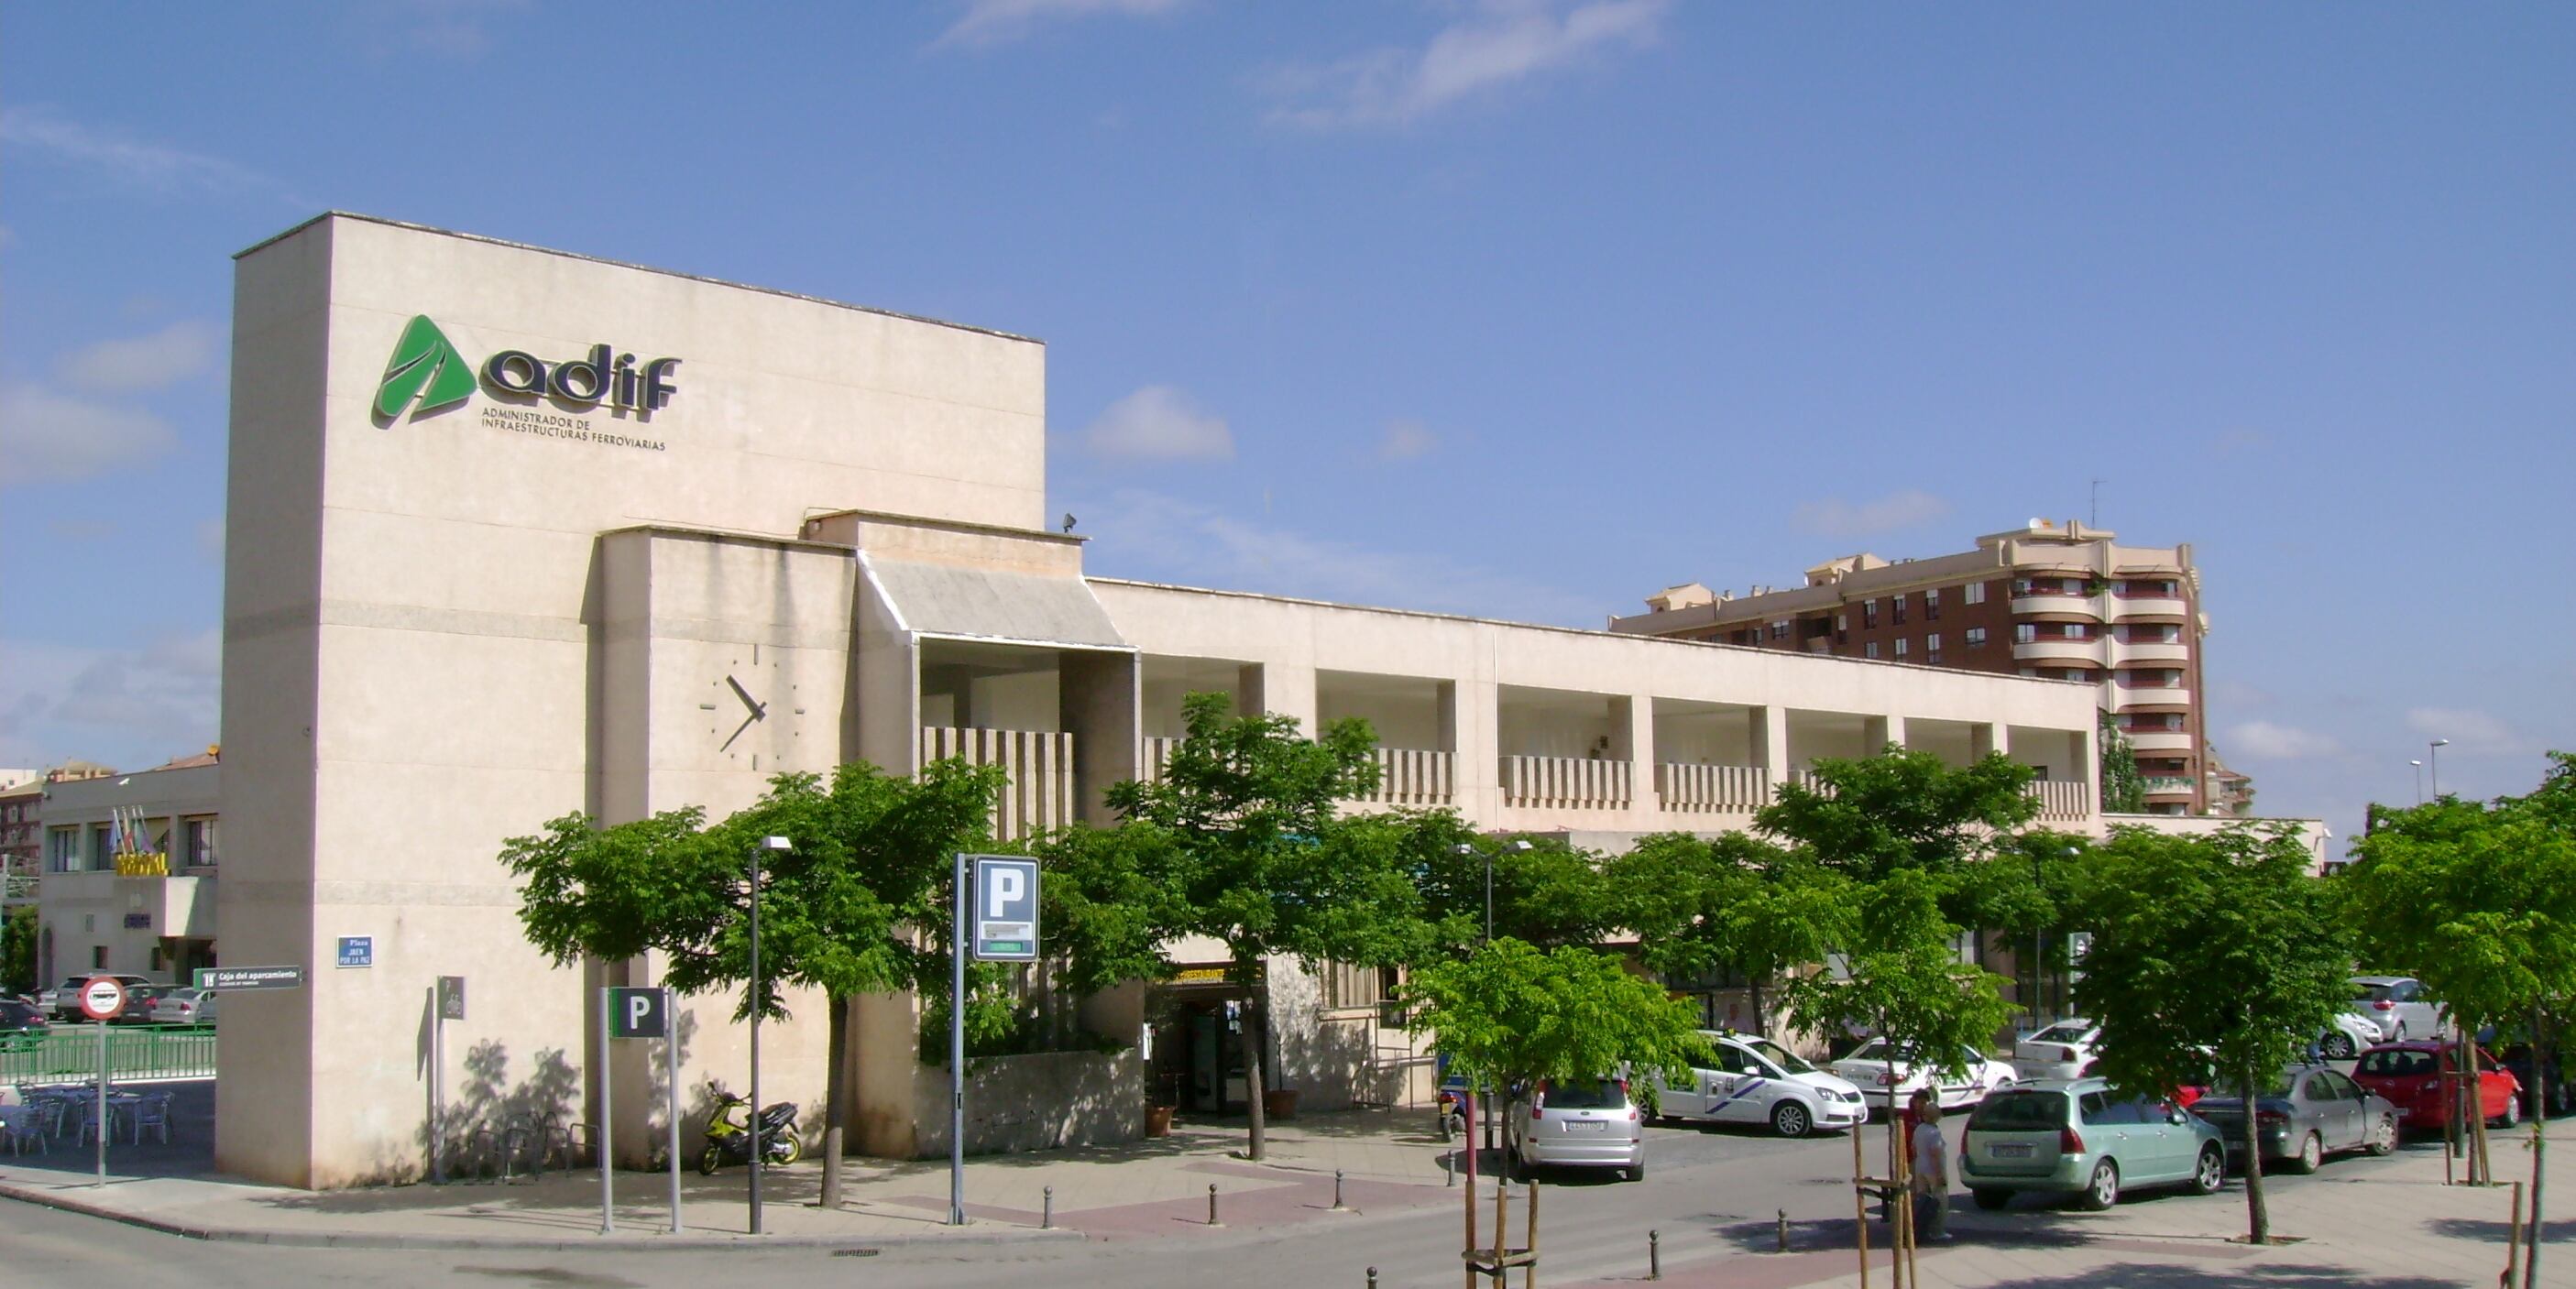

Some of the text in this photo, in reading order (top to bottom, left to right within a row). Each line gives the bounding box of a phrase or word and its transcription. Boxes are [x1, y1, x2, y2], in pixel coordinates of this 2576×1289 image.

[480, 343, 682, 412] adif
[481, 419, 665, 452] INFRAESTRUCTURAS FERROVIARIAS
[482, 407, 590, 431] ADMINISTRADOR DE
[990, 868, 1025, 917] P
[219, 970, 297, 981] Caja del aparcamiento
[630, 996, 651, 1030] P
